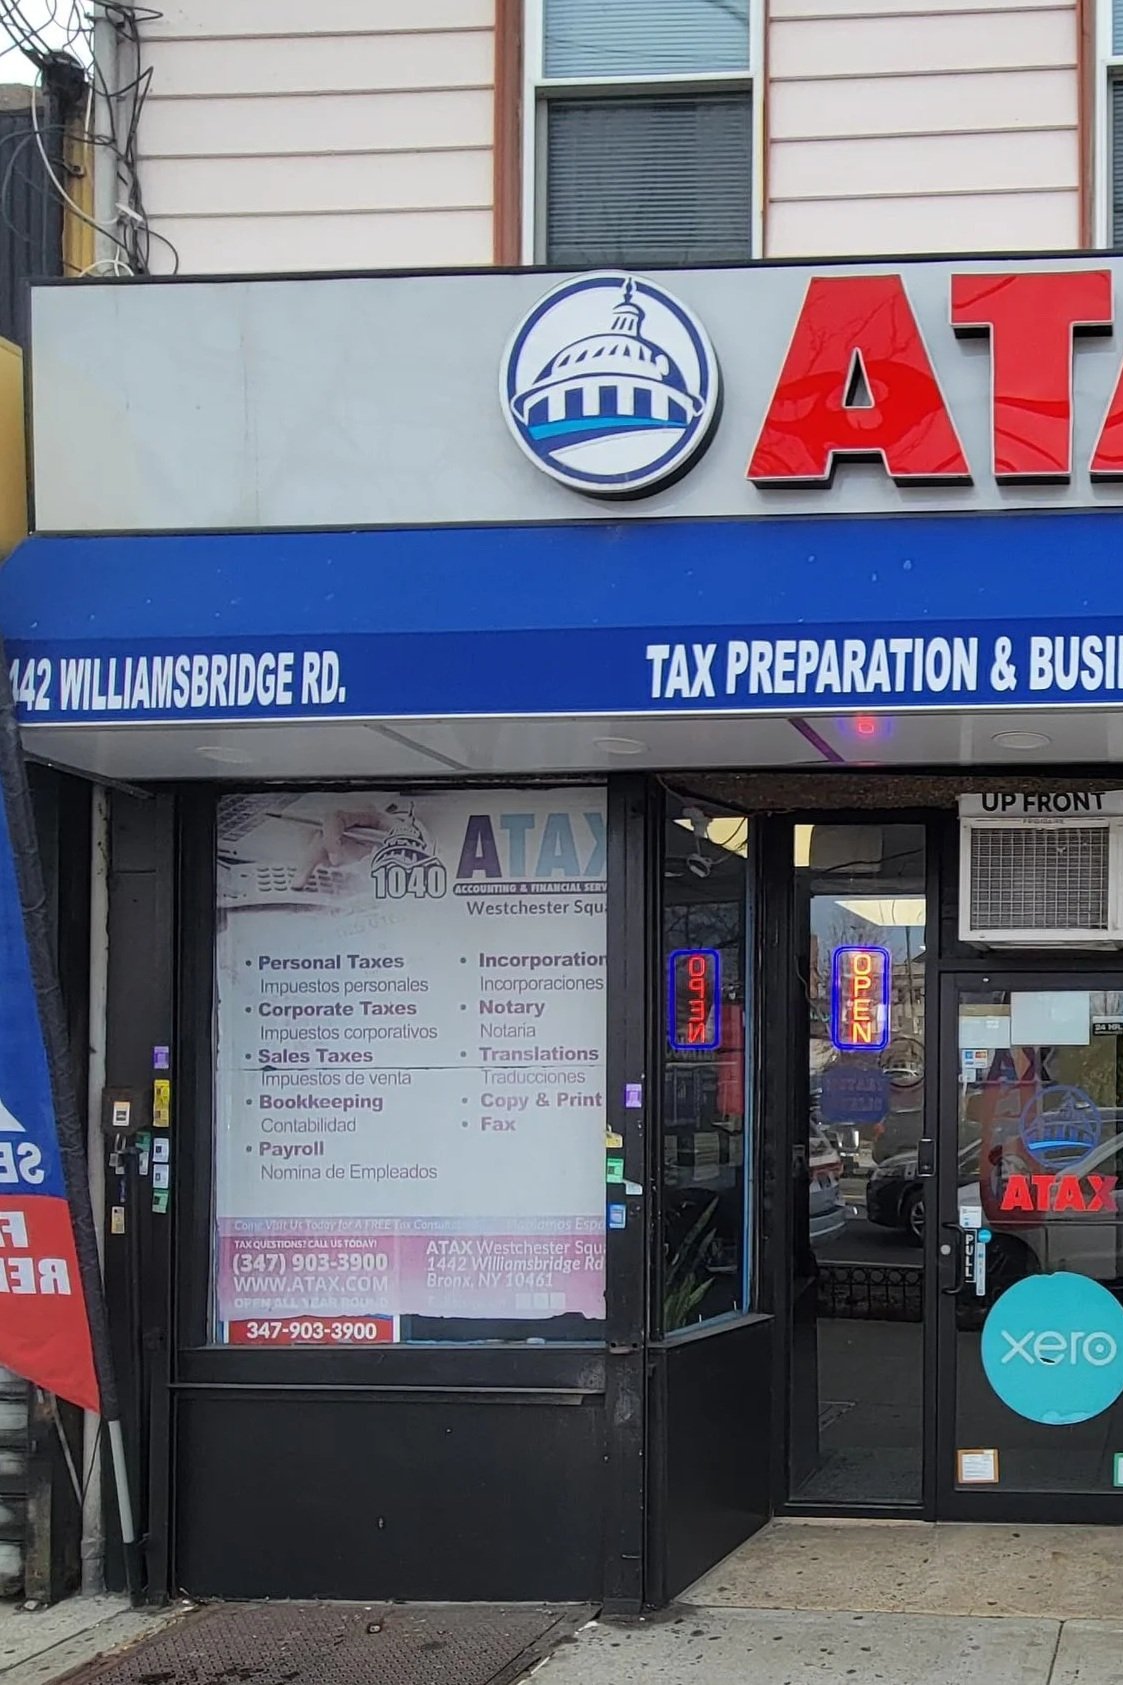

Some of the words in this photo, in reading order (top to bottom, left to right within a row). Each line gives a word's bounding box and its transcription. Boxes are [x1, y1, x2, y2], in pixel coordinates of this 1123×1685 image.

[645, 643, 718, 700] TAX
[726, 636, 978, 695] PREPARATION
[991, 636, 1017, 690] &
[9, 658, 51, 711] 442
[60, 652, 295, 711] WILLIAMSBRIDGE
[301, 650, 346, 704] RD.
[981, 792, 1017, 811] UP
[1023, 791, 1106, 812] FRONT
[371, 864, 447, 899] 1040
[455, 884, 517, 894] ACCOUNTING
[519, 884, 528, 893] &
[531, 883, 582, 893] FINANCIAL
[584, 882, 607, 892] SERV
[467, 900, 569, 916] Westchester
[258, 954, 341, 970] Personal
[347, 954, 405, 969] Taxes
[260, 977, 340, 995] Impuestos
[344, 977, 429, 995] personales
[480, 974, 604, 994] Incorporaciones
[852, 953, 873, 1044] OPEN
[258, 1002, 354, 1019] Corporate
[359, 1001, 417, 1016] Taxes
[479, 1000, 545, 1018] Notary
[260, 1024, 340, 1042] Impuestos
[343, 1024, 438, 1042] corporativos
[258, 1048, 310, 1064] Sales
[316, 1048, 373, 1063] Taxes
[479, 1046, 599, 1062] Translations
[261, 1070, 341, 1088] Impuestos
[344, 1070, 365, 1085] de
[368, 1070, 412, 1086] venta
[481, 1069, 586, 1085] Traducciones
[259, 1094, 384, 1112] Bookkeeping
[480, 1092, 529, 1111] Copy
[536, 1093, 550, 1108] &
[556, 1092, 603, 1108] Print
[261, 1117, 356, 1133] Contabilidad
[480, 1117, 516, 1132] Fax
[259, 1141, 325, 1158] Payroll
[261, 1165, 321, 1180] Nomina
[325, 1165, 345, 1180] de
[349, 1164, 438, 1183] Empleados
[1000, 1174, 1119, 1212] ATAX
[366, 1219, 391, 1230] FREE
[235, 1239, 252, 1249] TAX
[253, 1239, 306, 1249] QUESTIONS?
[308, 1239, 328, 1249] CALL
[331, 1239, 343, 1248] US
[344, 1239, 377, 1248] TODAY!
[426, 1240, 473, 1255] ATAX
[476, 1240, 569, 1255] Westchester
[232, 1253, 286, 1275] (347)
[292, 1253, 388, 1272] 903-3900
[964, 1233, 974, 1278] PULL
[427, 1256, 467, 1271] 1442
[472, 1256, 581, 1274] Williamsbridge
[584, 1256, 604, 1271] Rd
[234, 1275, 388, 1292] WWW.ATAX.COM
[427, 1273, 474, 1289] Bronx,
[478, 1273, 501, 1287] NY
[505, 1272, 553, 1287] 10461
[246, 1321, 377, 1340] 347-903-3900
[1000, 1329, 1117, 1367] xero
